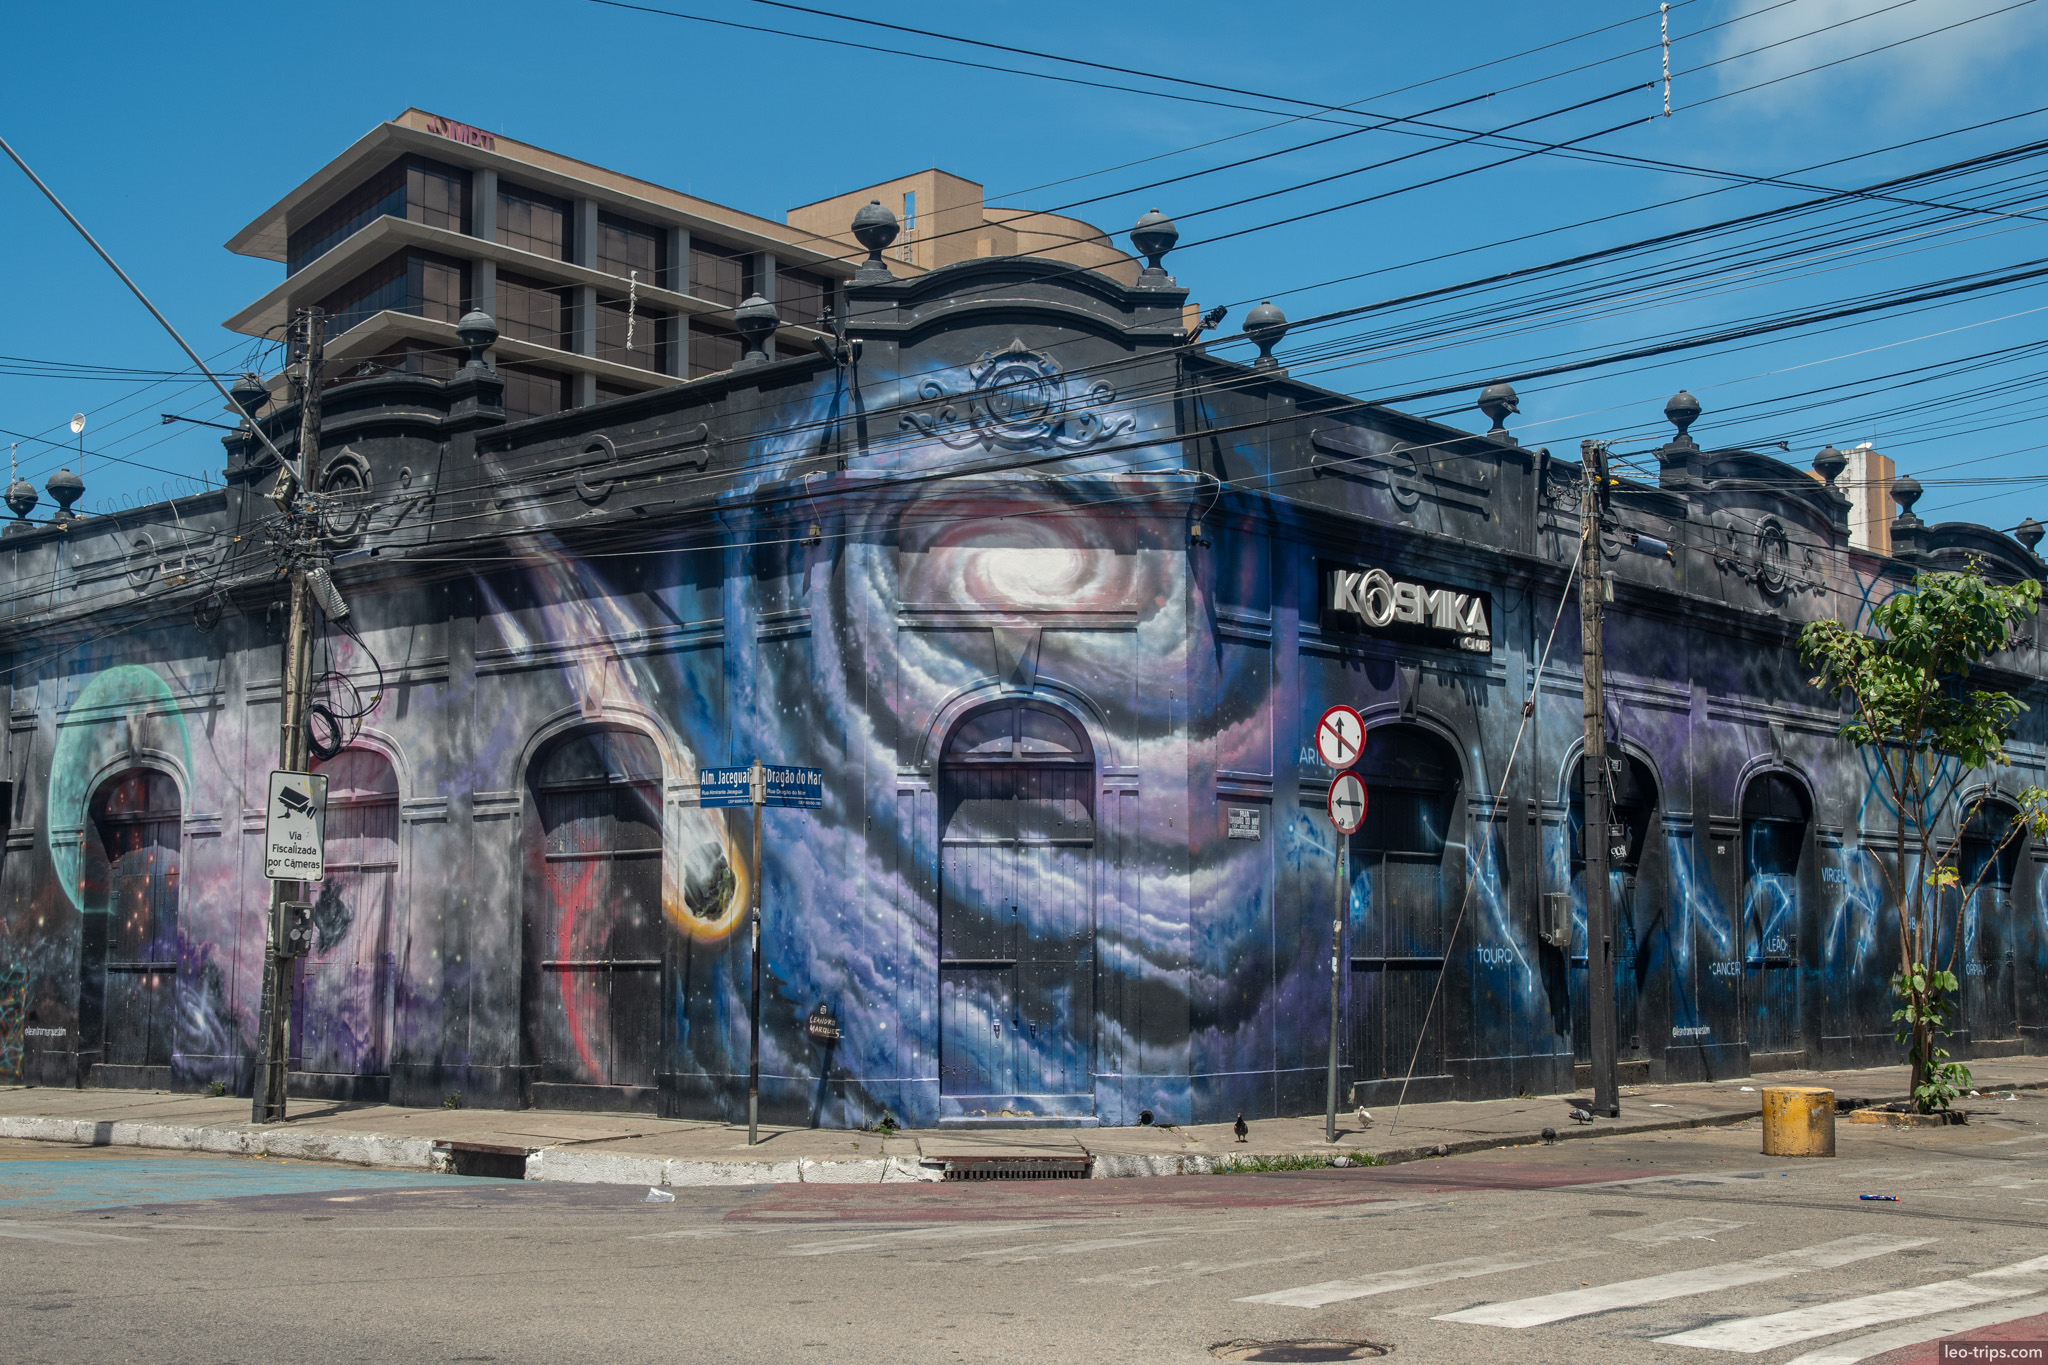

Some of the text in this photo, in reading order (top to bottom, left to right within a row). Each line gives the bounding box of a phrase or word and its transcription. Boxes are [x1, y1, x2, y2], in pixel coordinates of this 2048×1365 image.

[1333, 568, 1490, 636] KOSMIKA
[1464, 637, 1491, 652] CLUB
[701, 768, 750, 788] Alm. Jaceguai
[767, 768, 822, 787] Dragão do Mar
[289, 831, 302, 841] Via
[272, 843, 317, 855] Fiscalizada
[267, 858, 321, 869] por Câmeras
[1768, 935, 1788, 952] LEÃO
[1477, 948, 1513, 963] TOURO
[809, 1014, 836, 1026] LEANDRO
[809, 1024, 841, 1038] MARQUES
